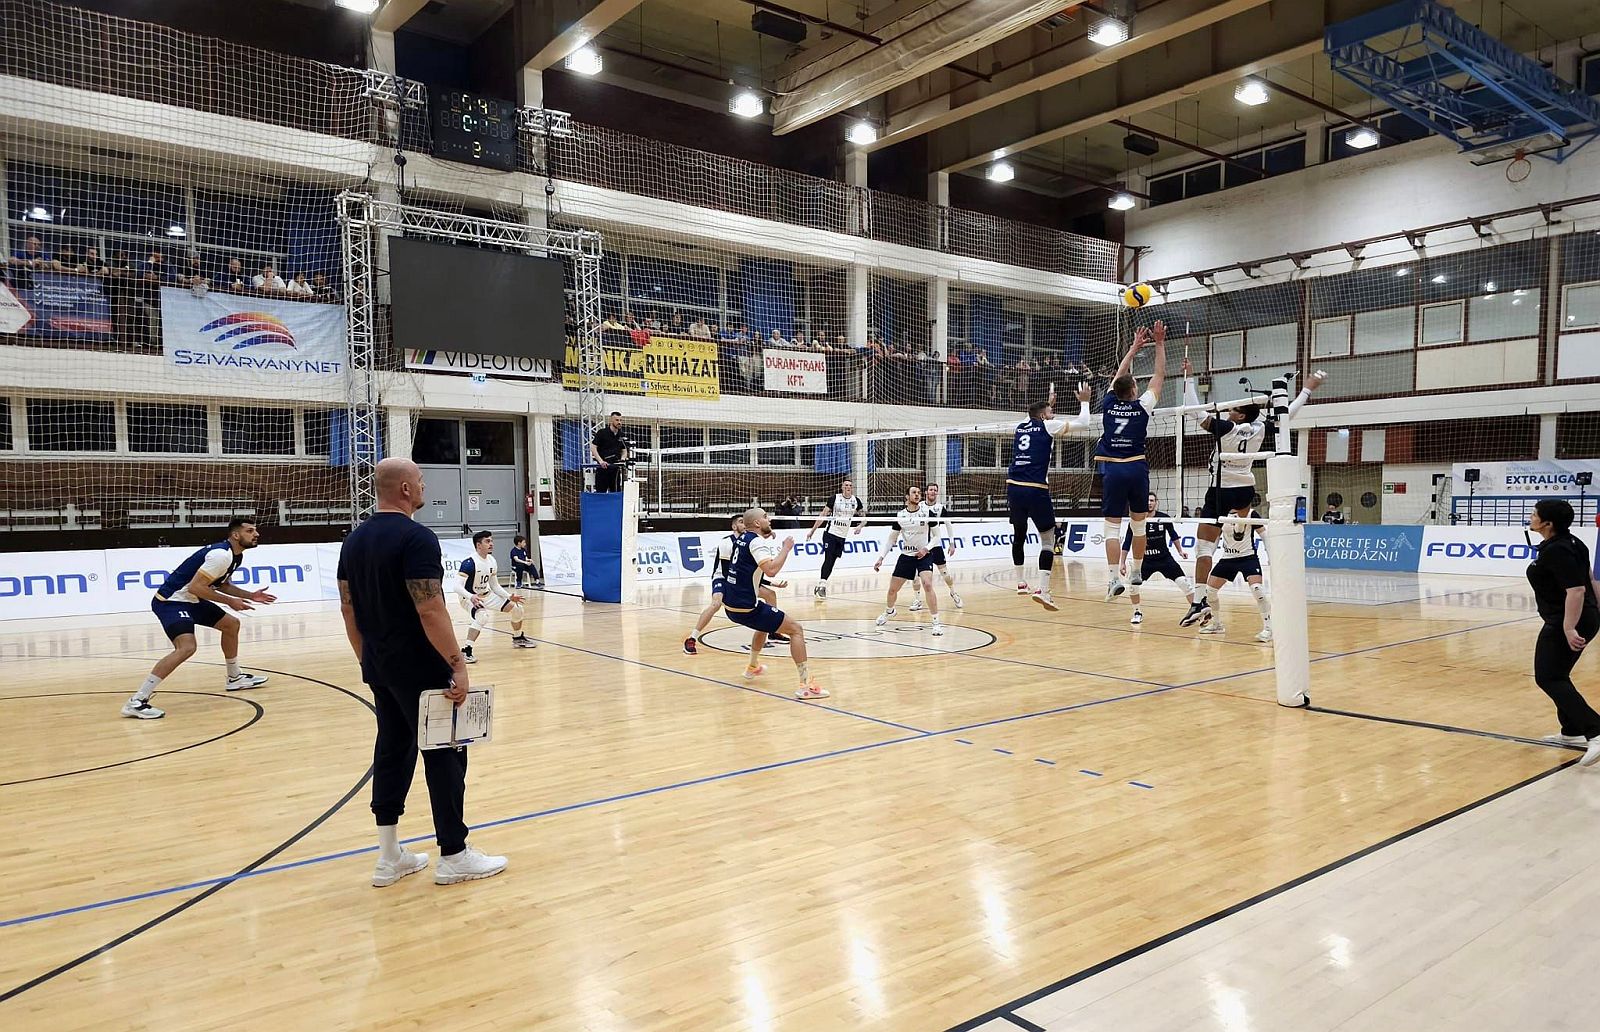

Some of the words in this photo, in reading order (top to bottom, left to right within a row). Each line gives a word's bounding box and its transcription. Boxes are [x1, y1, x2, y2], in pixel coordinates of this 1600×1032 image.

[645, 352, 718, 378] RUHÁZAT
[765, 357, 825, 372] DURAN-TRANS
[787, 375, 805, 387] KFT.
[1113, 418, 1130, 434] 7
[1018, 434, 1031, 451] 3
[1506, 474, 1576, 485] EXTRALIGA
[1312, 537, 1352, 548] GYERE
[1357, 538, 1371, 549] TE
[1376, 539, 1387, 549] IS
[1304, 547, 1399, 562] ÖPLABDÁZNI!
[480, 575, 489, 584] 10
